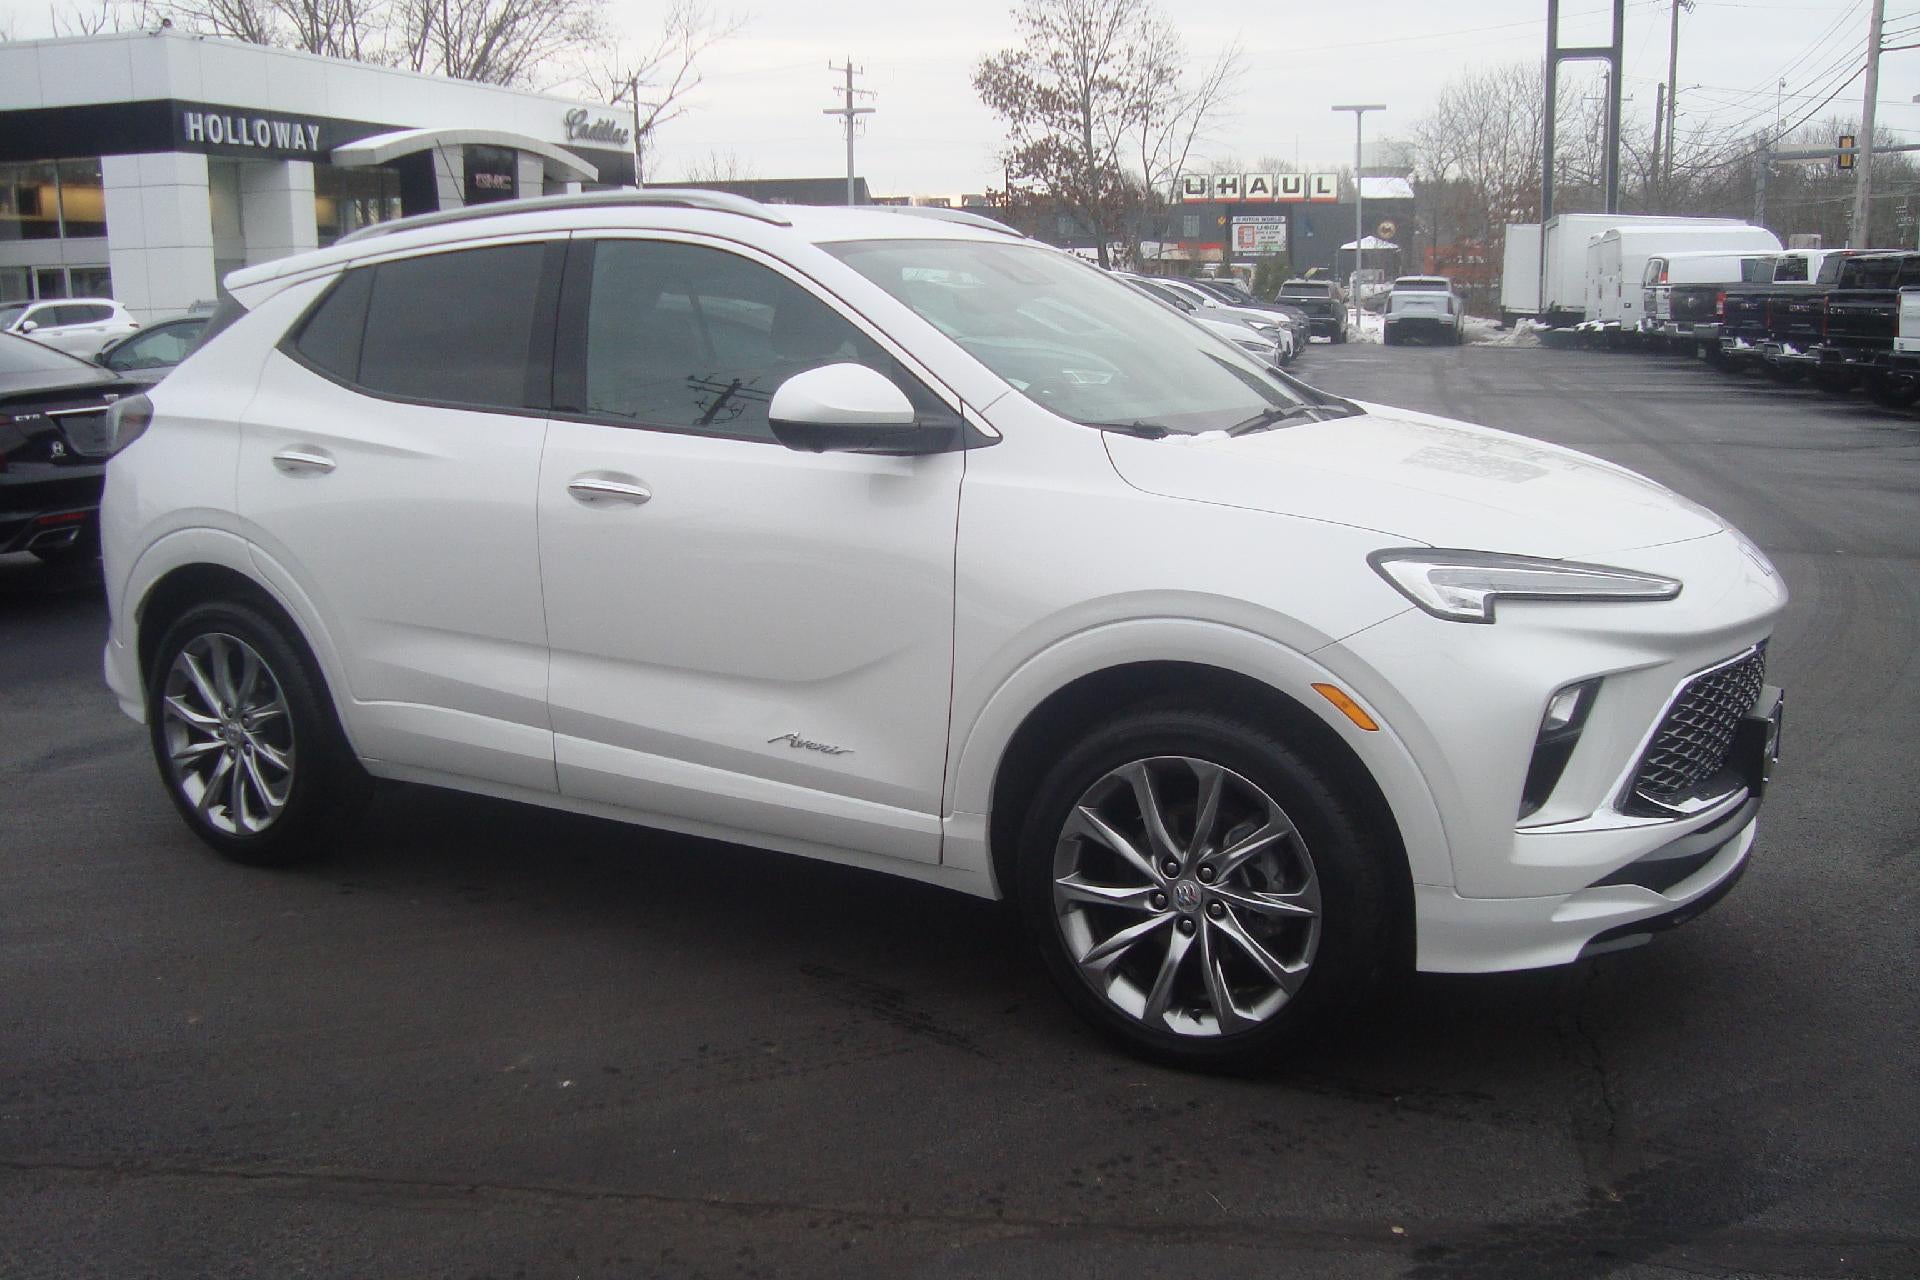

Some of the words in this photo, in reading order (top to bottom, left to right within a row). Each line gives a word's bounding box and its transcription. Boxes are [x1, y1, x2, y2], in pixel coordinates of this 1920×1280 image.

[184, 112, 320, 152] HOLLOWAY
[563, 108, 628, 144] Cadillac
[475, 173, 512, 190] GMC
